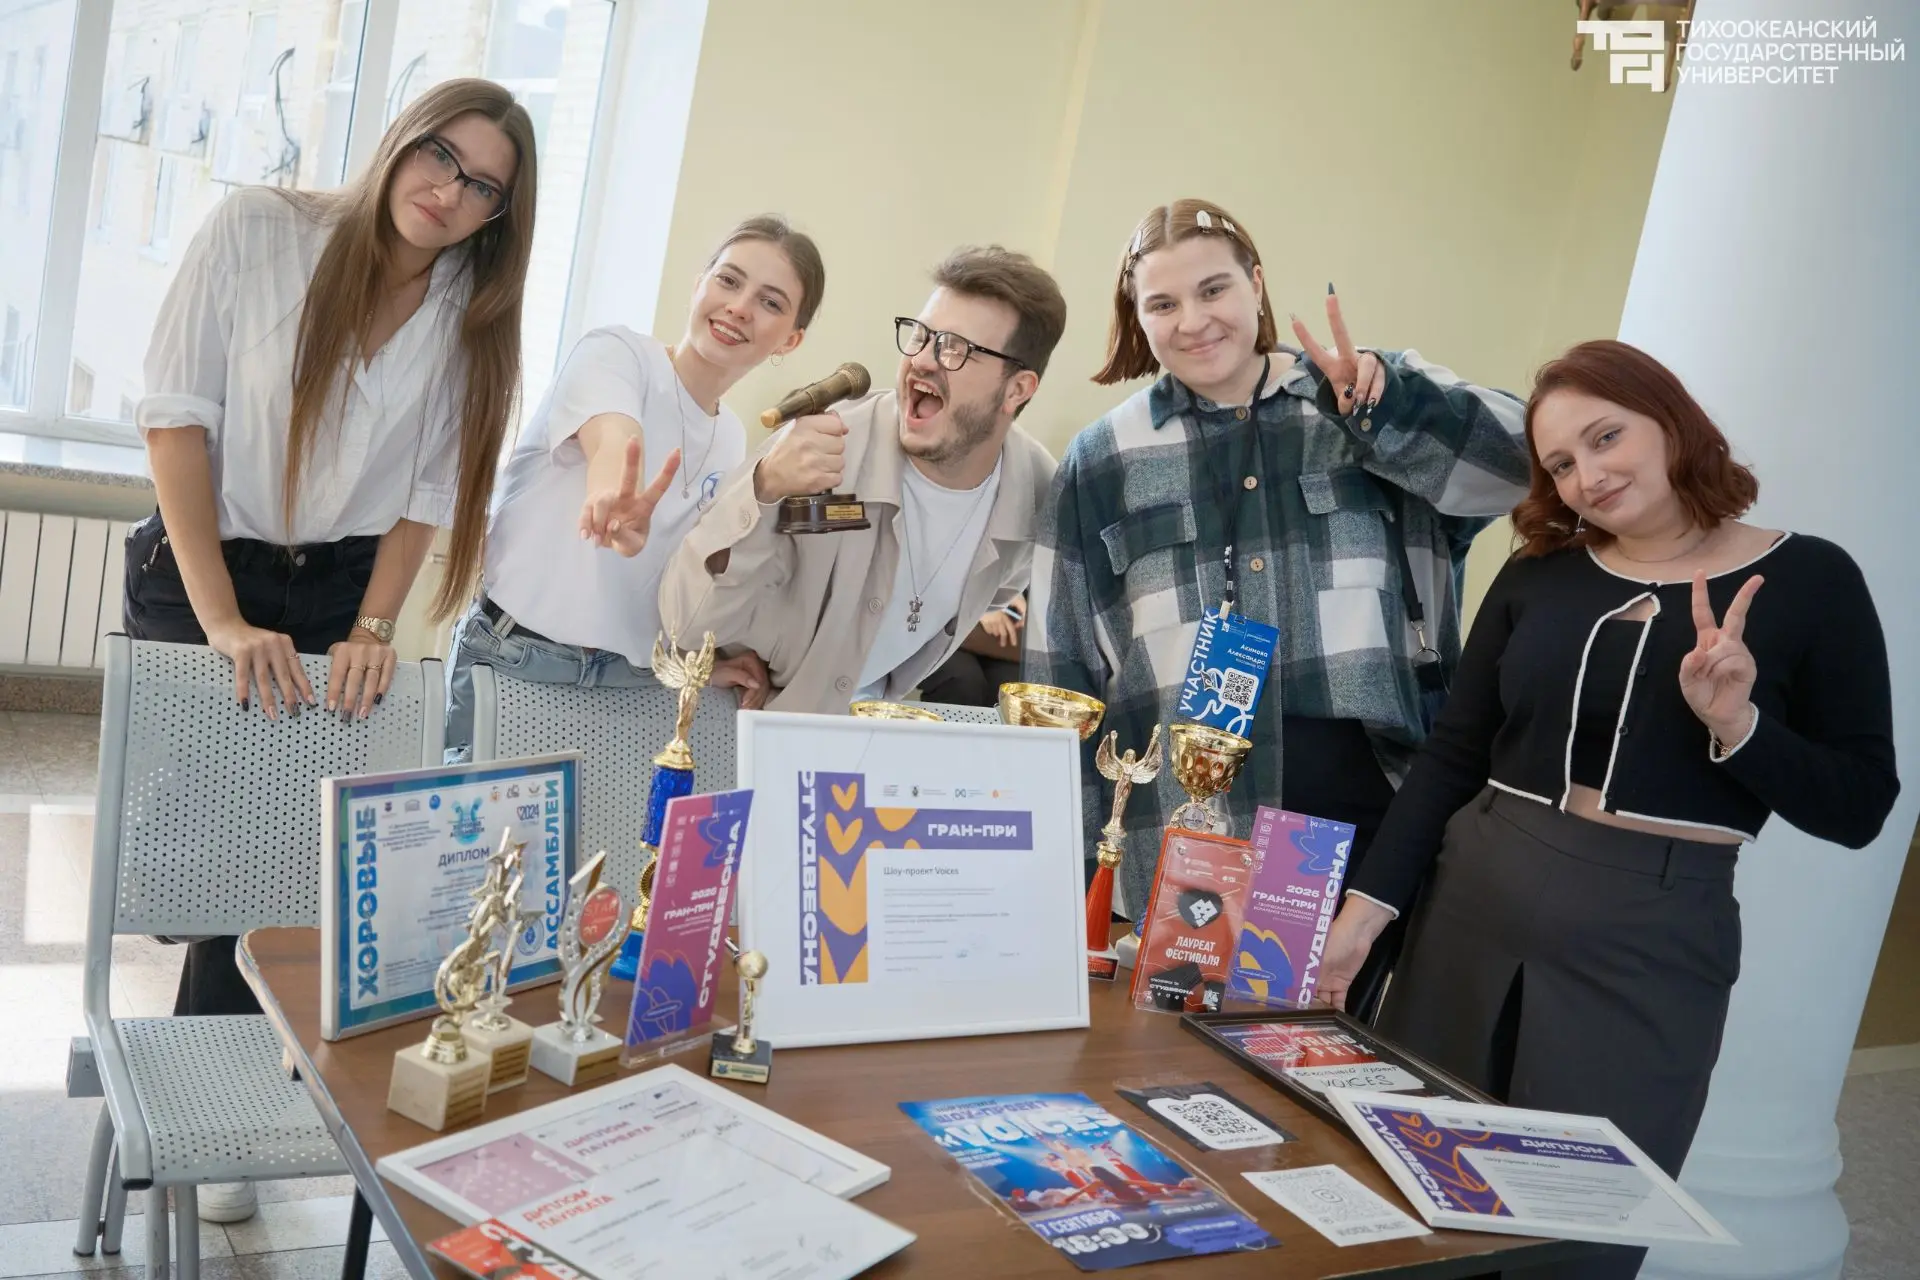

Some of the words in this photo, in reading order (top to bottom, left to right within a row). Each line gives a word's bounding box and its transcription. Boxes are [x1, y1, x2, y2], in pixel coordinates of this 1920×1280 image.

[1180, 610, 1219, 712] УЧАСТНИК
[927, 823, 1017, 838] ГРАН-ПРИ
[438, 846, 490, 868] ДИПЛОМ
[544, 779, 561, 951] АССАМБЛЕИ
[883, 866, 933, 877] Шоу-проект
[935, 866, 959, 875] Voices
[355, 806, 380, 999] ХОРОВЫЕ
[1252, 890, 1316, 910] ГРАН-ПРИ
[664, 901, 714, 920] ГРАН-ПРИ
[699, 820, 741, 1008] СТУДВЕСНА
[1297, 839, 1350, 1009] СТУДВЕСНА
[1176, 936, 1216, 952] ЛАУРЕАТ
[1165, 948, 1220, 967] ФЕСТИВАЛЯ
[1298, 1034, 1357, 1047] GRAND
[1311, 1044, 1376, 1058] PRIX
[1320, 1074, 1394, 1089] VOICES
[1520, 1139, 1607, 1155] ДИПЛОМ
[522, 1189, 590, 1222] ДИПЛОМ
[538, 1195, 615, 1230] ЛАУРЕАТА
[1050, 1209, 1122, 1236] СЕНТЯБРЯ
